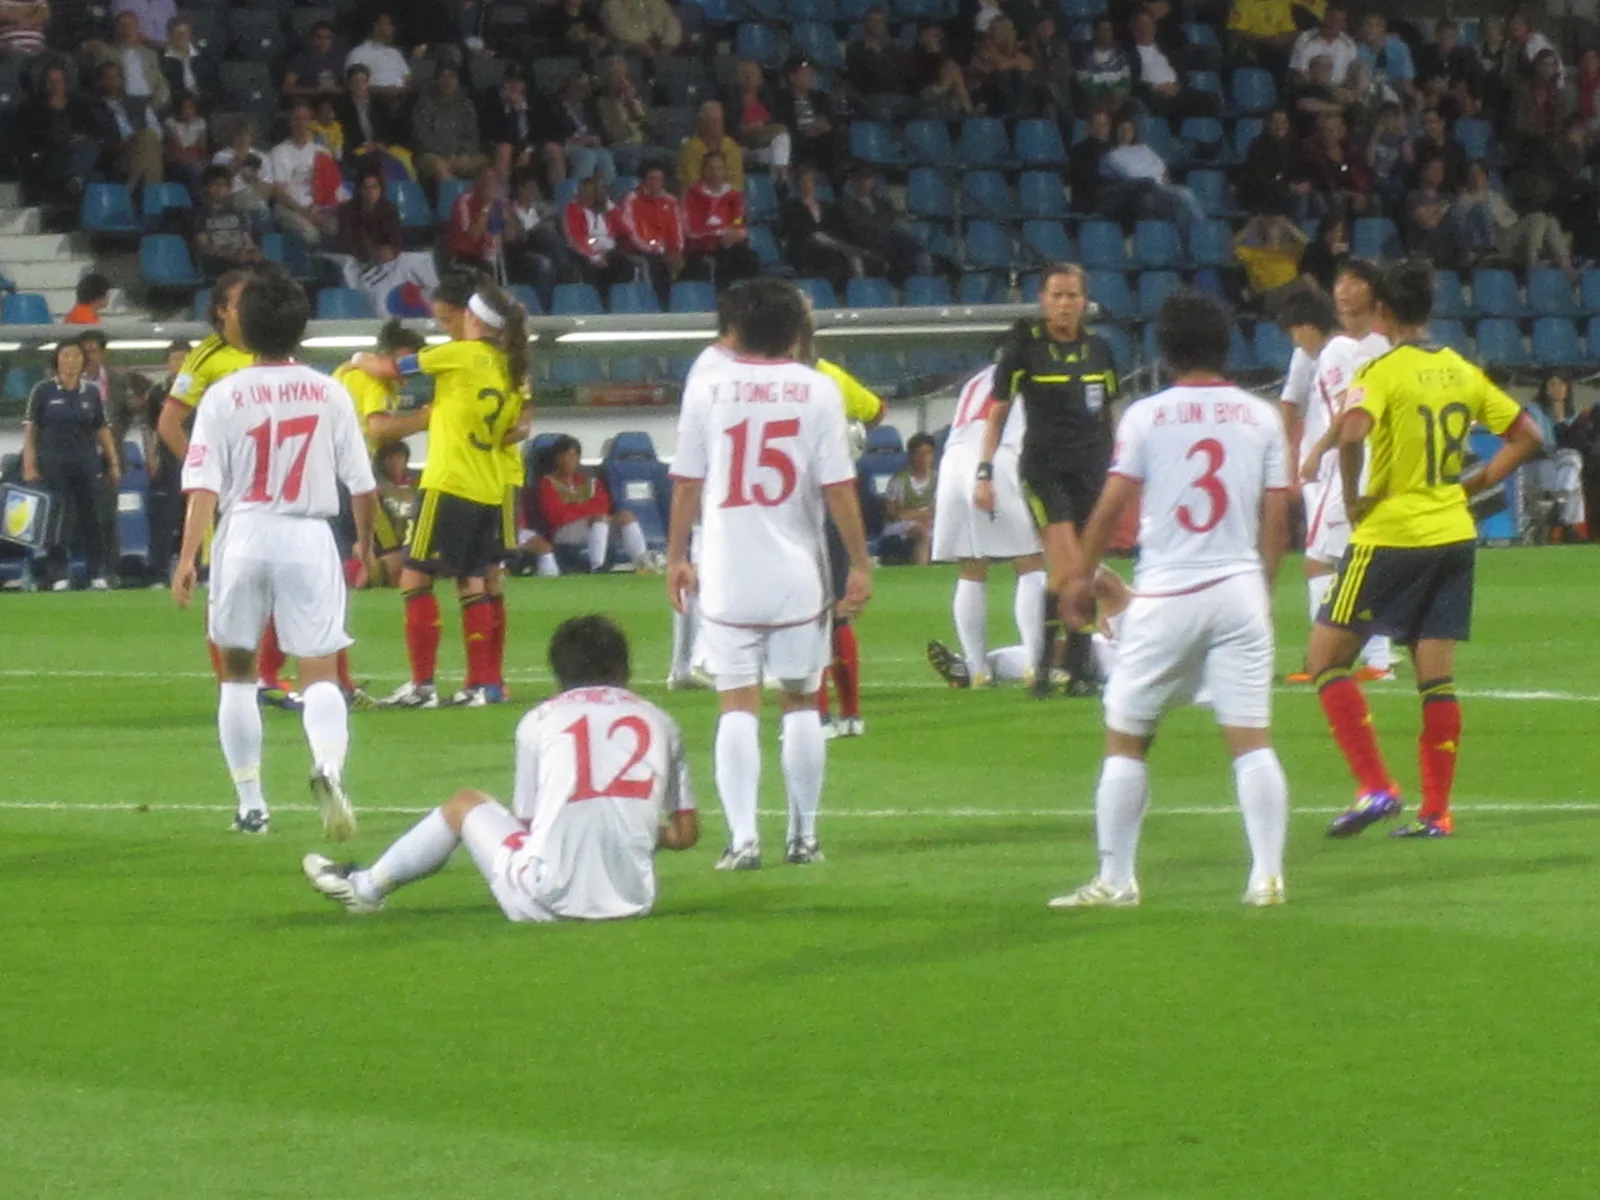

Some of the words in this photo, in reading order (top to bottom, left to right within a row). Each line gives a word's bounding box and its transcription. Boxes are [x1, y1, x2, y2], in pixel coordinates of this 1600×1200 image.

[250, 383, 272, 404] UN
[278, 382, 328, 403] HYANG
[468, 387, 505, 452] 3
[241, 414, 320, 504] 17
[719, 416, 802, 509] 15
[1175, 437, 1229, 534] 3
[1416, 402, 1471, 487] 18
[561, 714, 655, 804] 12
